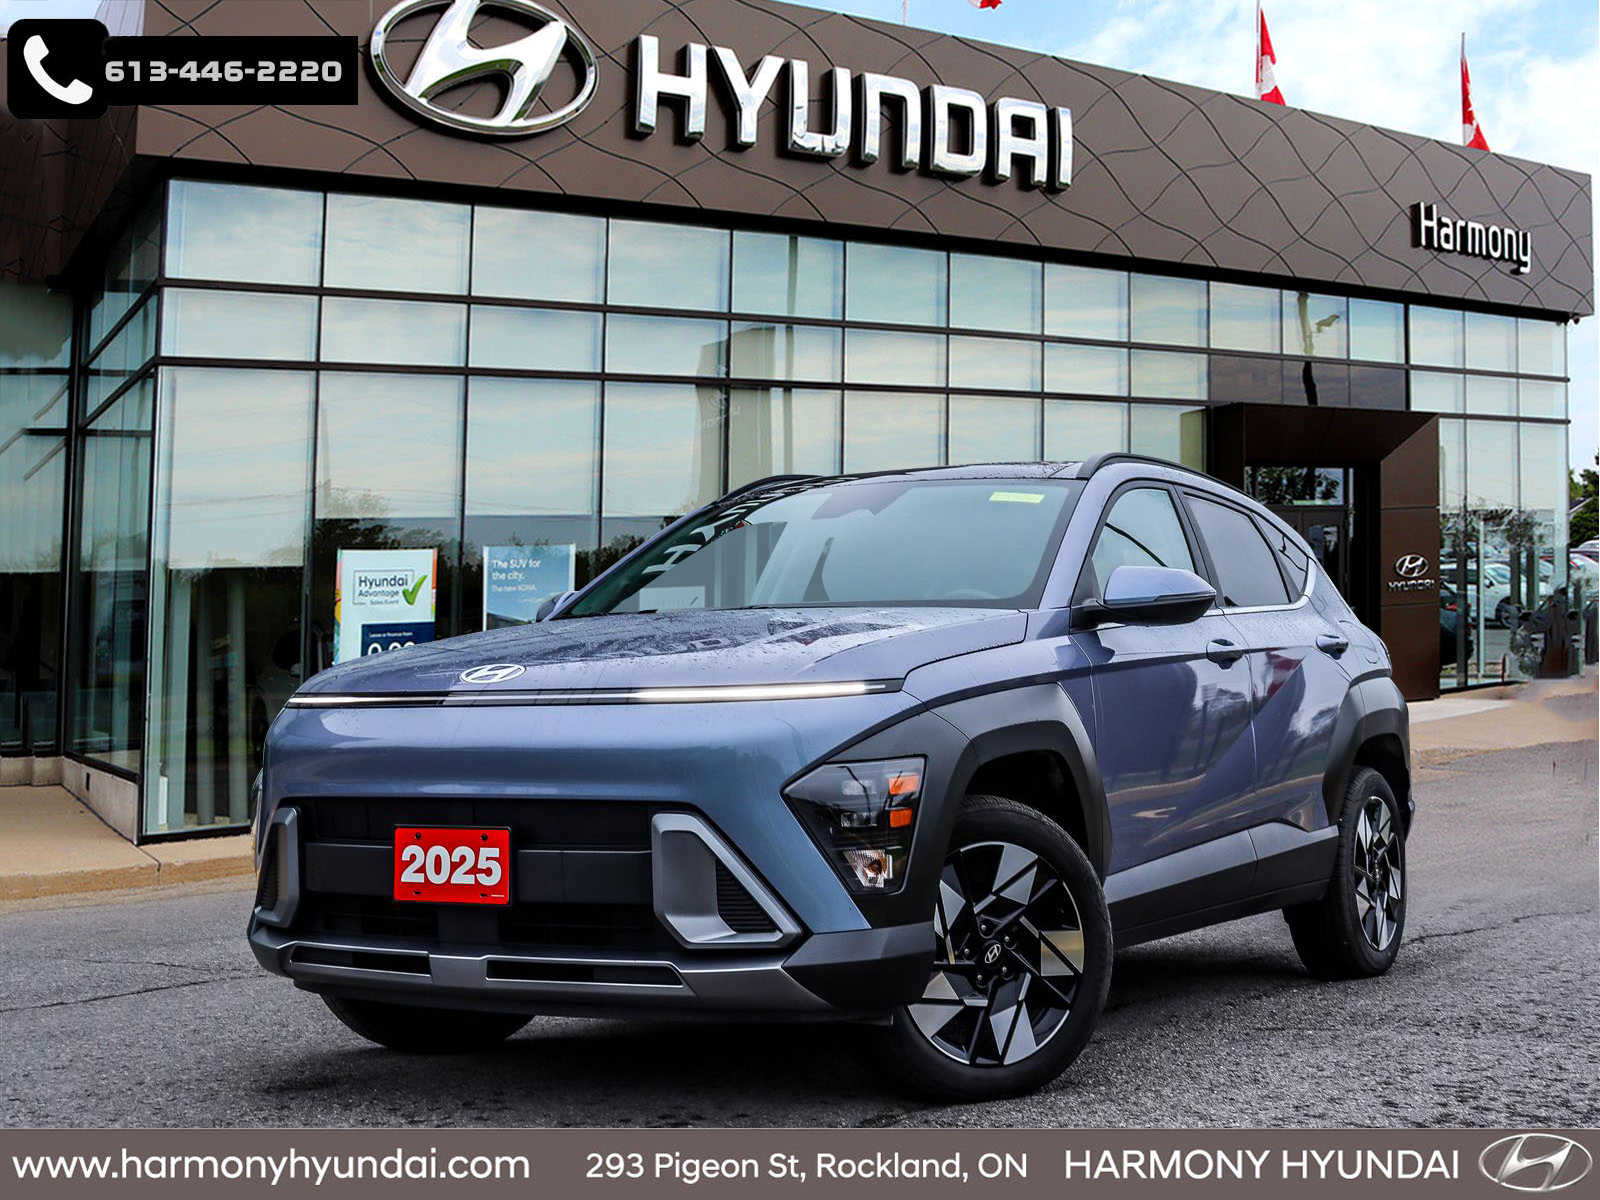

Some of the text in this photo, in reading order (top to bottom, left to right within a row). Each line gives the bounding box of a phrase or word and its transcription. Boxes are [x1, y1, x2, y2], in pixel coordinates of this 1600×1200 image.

[634, 34, 1073, 190] HYUNDAI
[1419, 201, 1531, 274] Harmony
[492, 558, 541, 569] The SUV for
[358, 573, 408, 590] Hyundai
[358, 589, 400, 598] Advantage
[401, 844, 502, 886] 2025
